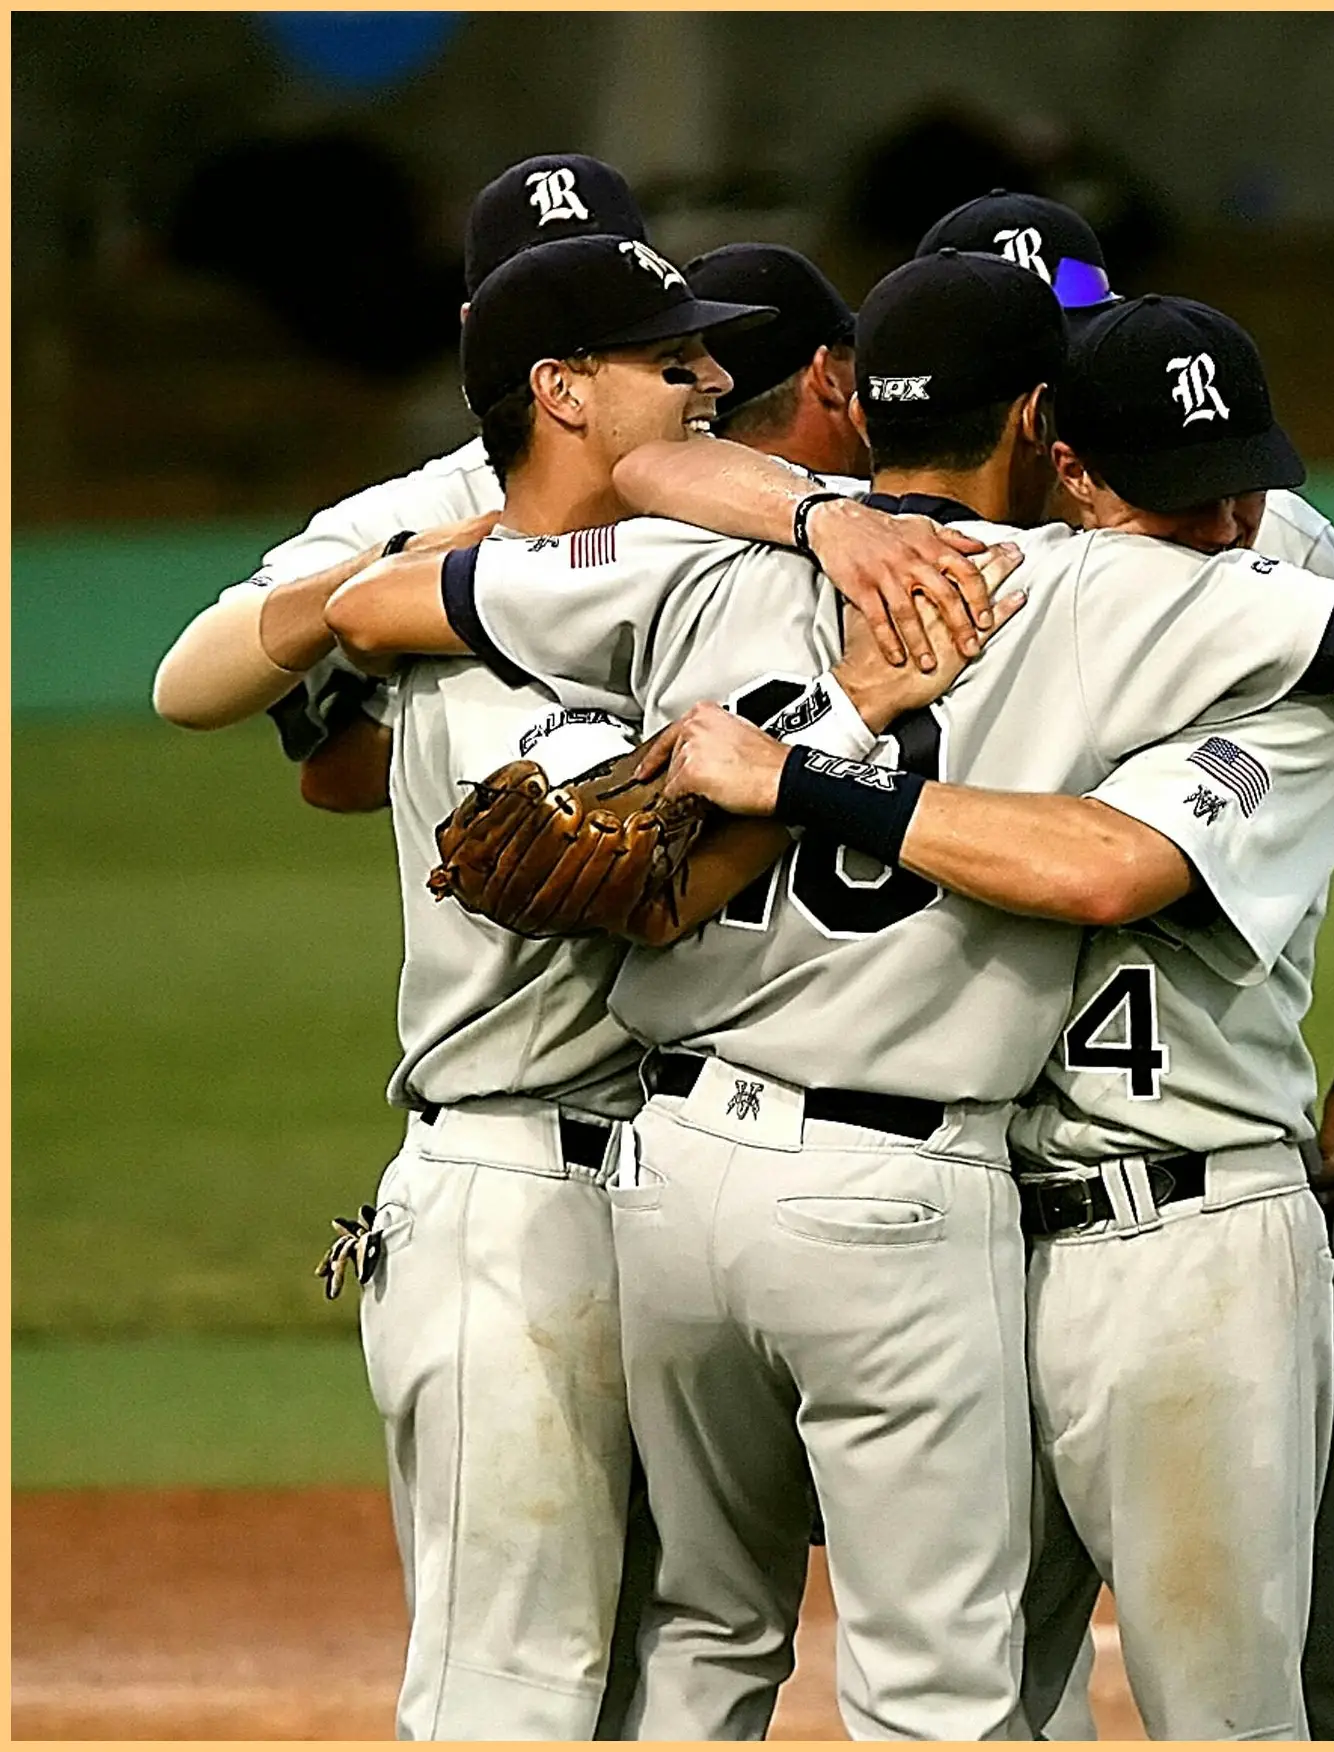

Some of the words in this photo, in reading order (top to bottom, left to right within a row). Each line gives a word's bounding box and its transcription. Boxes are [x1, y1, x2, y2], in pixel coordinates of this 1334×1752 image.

[524, 167, 590, 228] R
[868, 375, 932, 402] TPX
[1165, 352, 1230, 428] R
[803, 749, 908, 792] TPX
[1062, 962, 1171, 1102] 4
